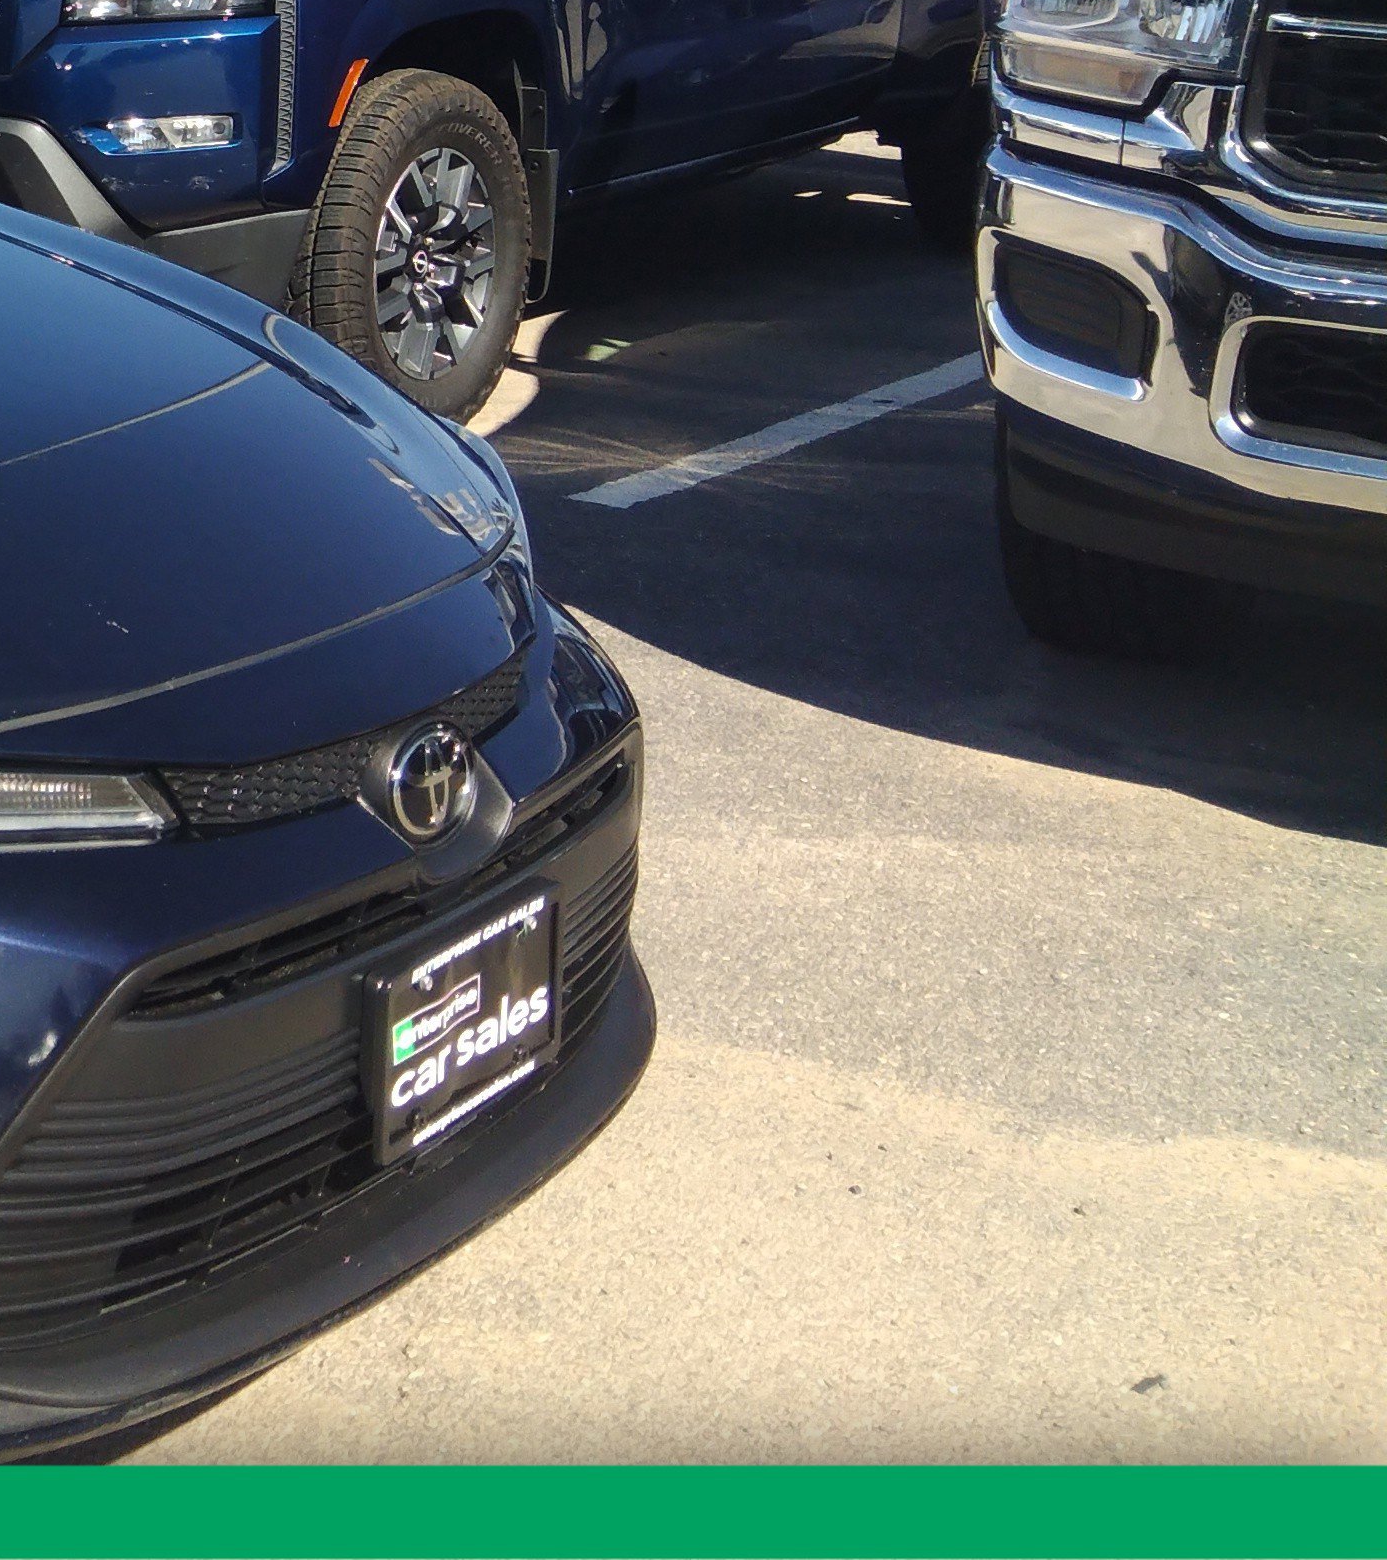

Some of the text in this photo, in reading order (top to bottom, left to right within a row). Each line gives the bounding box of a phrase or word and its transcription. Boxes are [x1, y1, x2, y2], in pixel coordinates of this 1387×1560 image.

[391, 1044, 452, 1108] car
[456, 985, 550, 1067] sales
[397, 987, 479, 1050] enterprise
